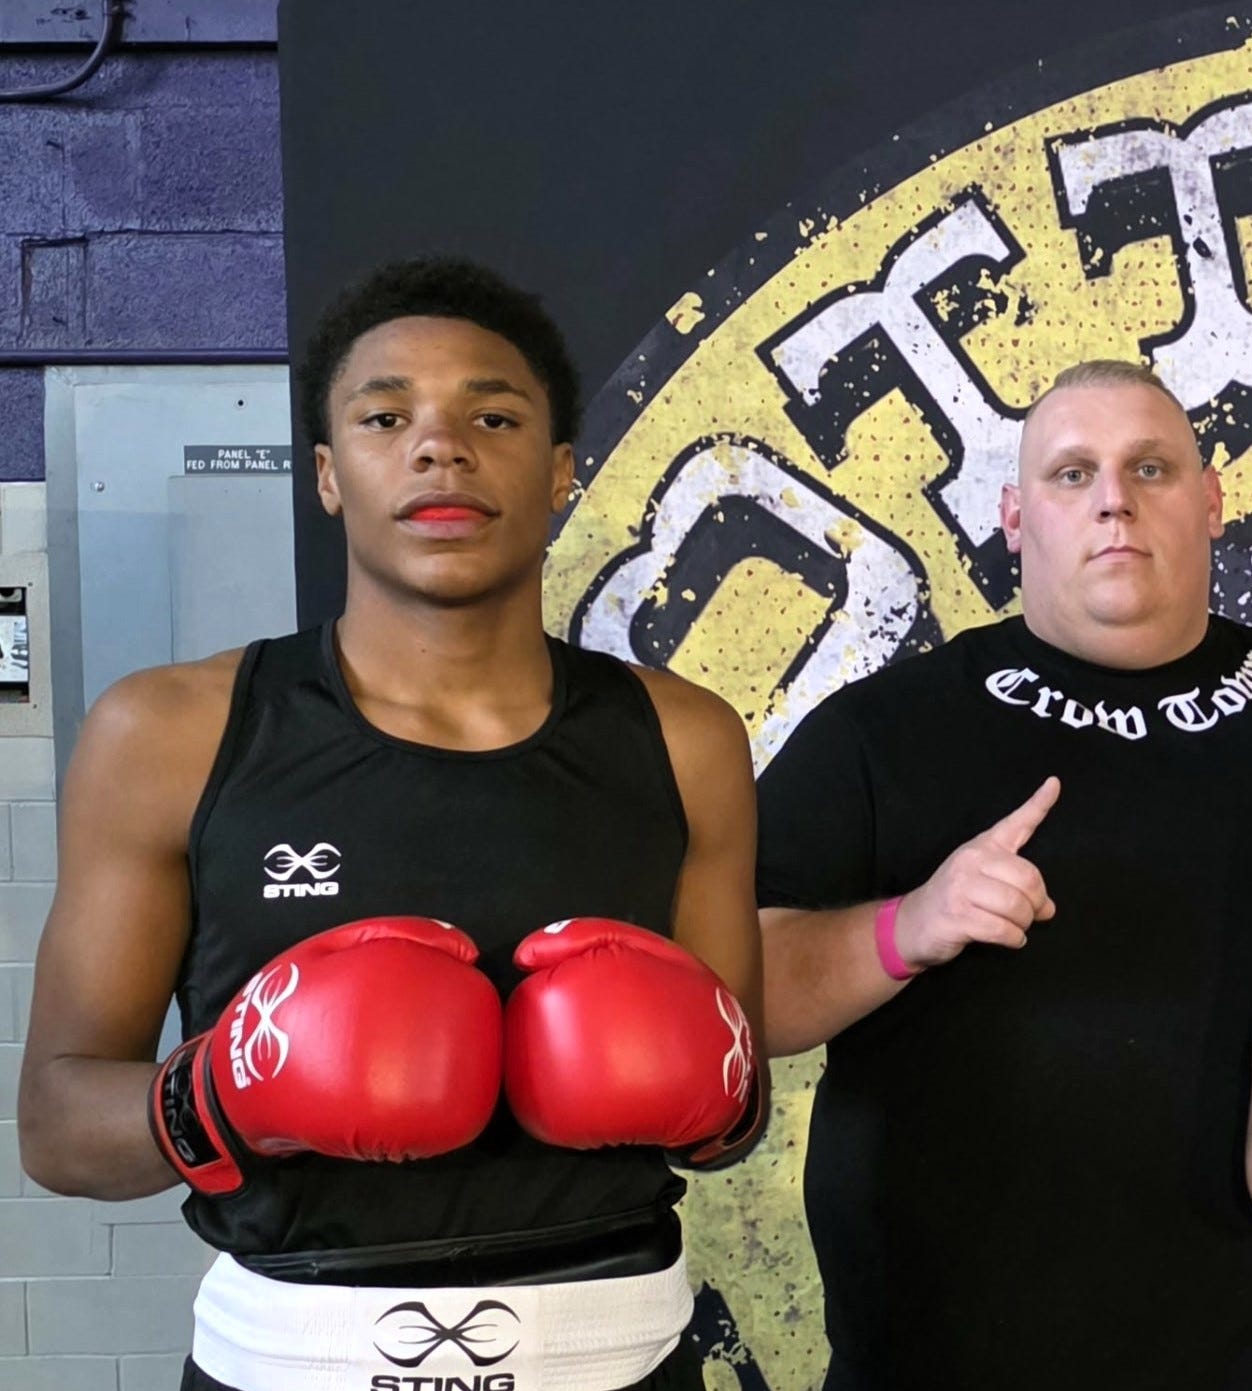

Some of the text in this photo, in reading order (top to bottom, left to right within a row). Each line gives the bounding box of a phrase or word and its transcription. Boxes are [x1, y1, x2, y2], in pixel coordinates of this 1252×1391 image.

[217, 449, 251, 460] PANEL
[186, 460, 206, 470] FED
[210, 460, 240, 470] FROM
[245, 460, 279, 470] PANEL
[985, 667, 1148, 740] Crow
[263, 881, 339, 899] STING
